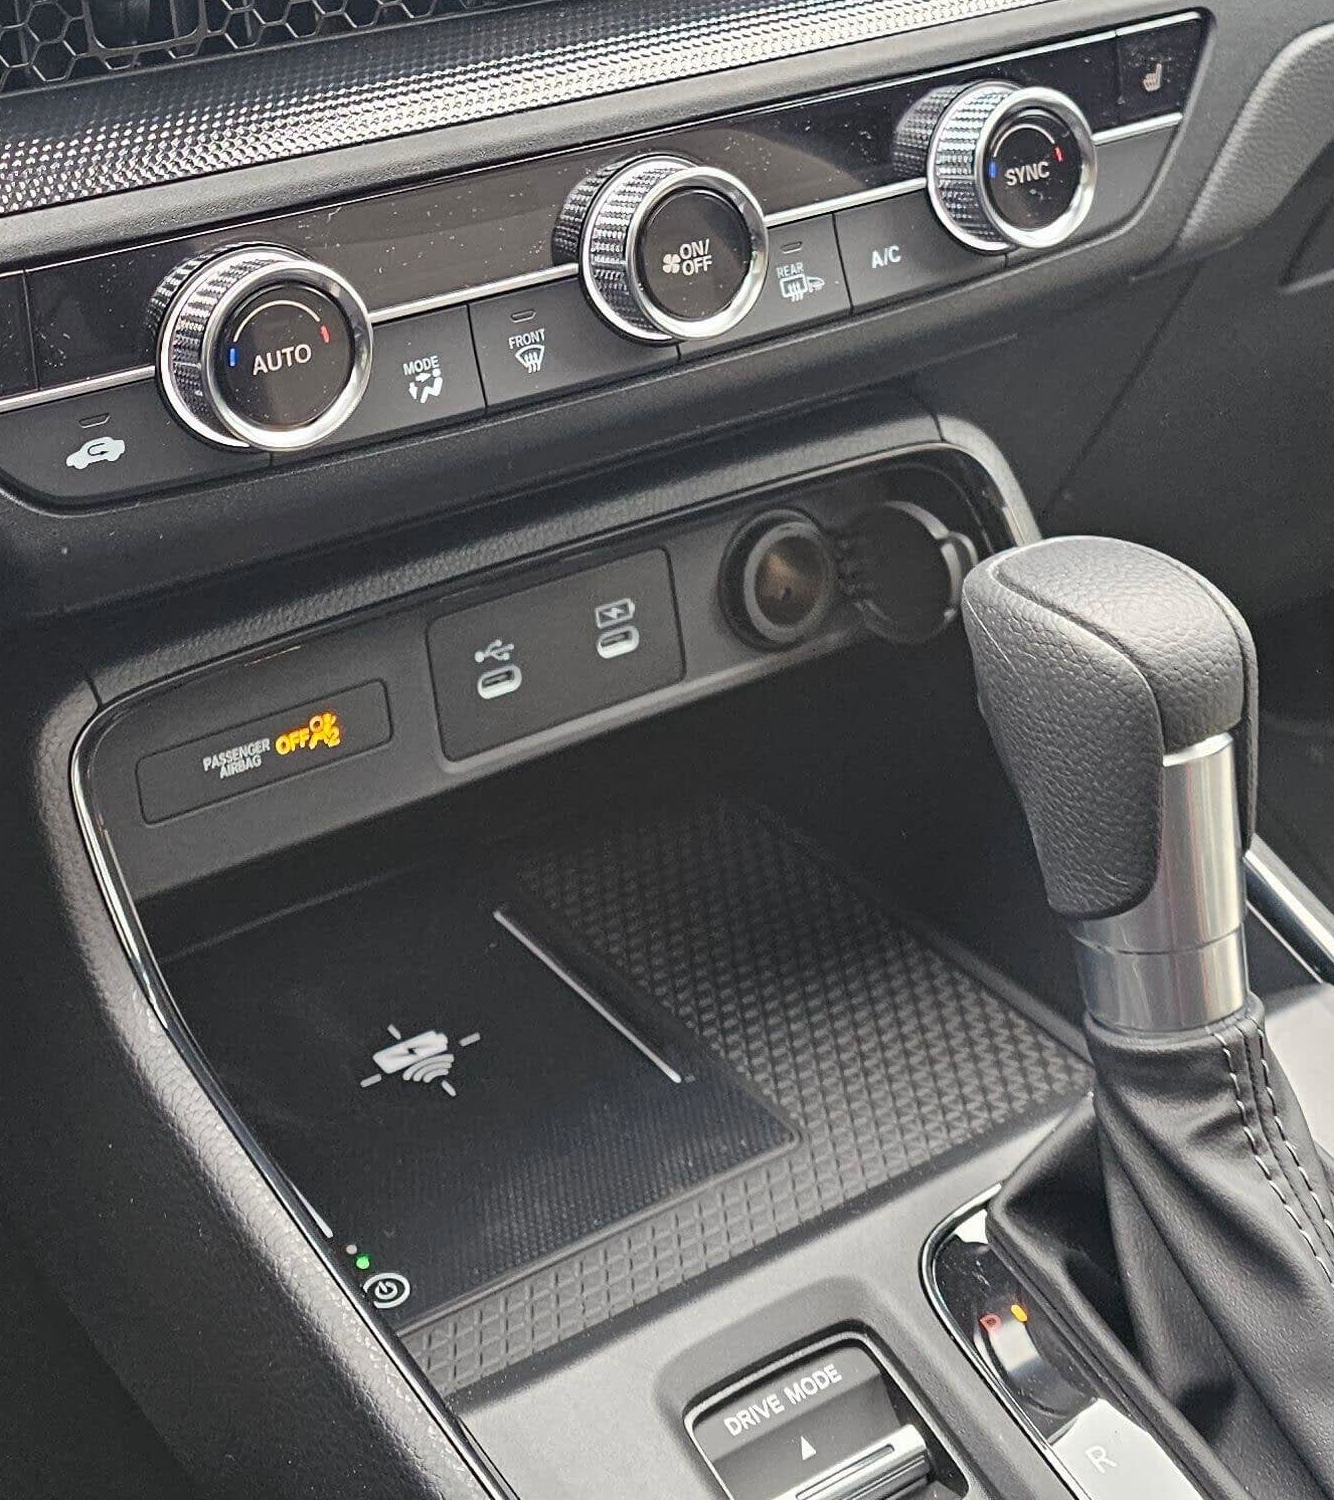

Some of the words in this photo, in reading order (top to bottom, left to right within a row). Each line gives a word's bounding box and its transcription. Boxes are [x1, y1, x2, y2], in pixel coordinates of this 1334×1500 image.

[1004, 160, 1051, 187] SYNC
[679, 238, 710, 260] ON/
[871, 245, 902, 269] A/C
[682, 255, 713, 276] OFF
[776, 262, 804, 279] REAR
[508, 328, 545, 350] FRONT
[251, 343, 312, 377] AUTO
[403, 355, 440, 376] MODE
[275, 728, 310, 756] OFF
[203, 739, 270, 770] PASSENGER
[220, 755, 262, 779] AIRBAG
[723, 1393, 785, 1437] DRIVE
[783, 1363, 843, 1404] MODE
[1085, 1444, 1119, 1474] R
